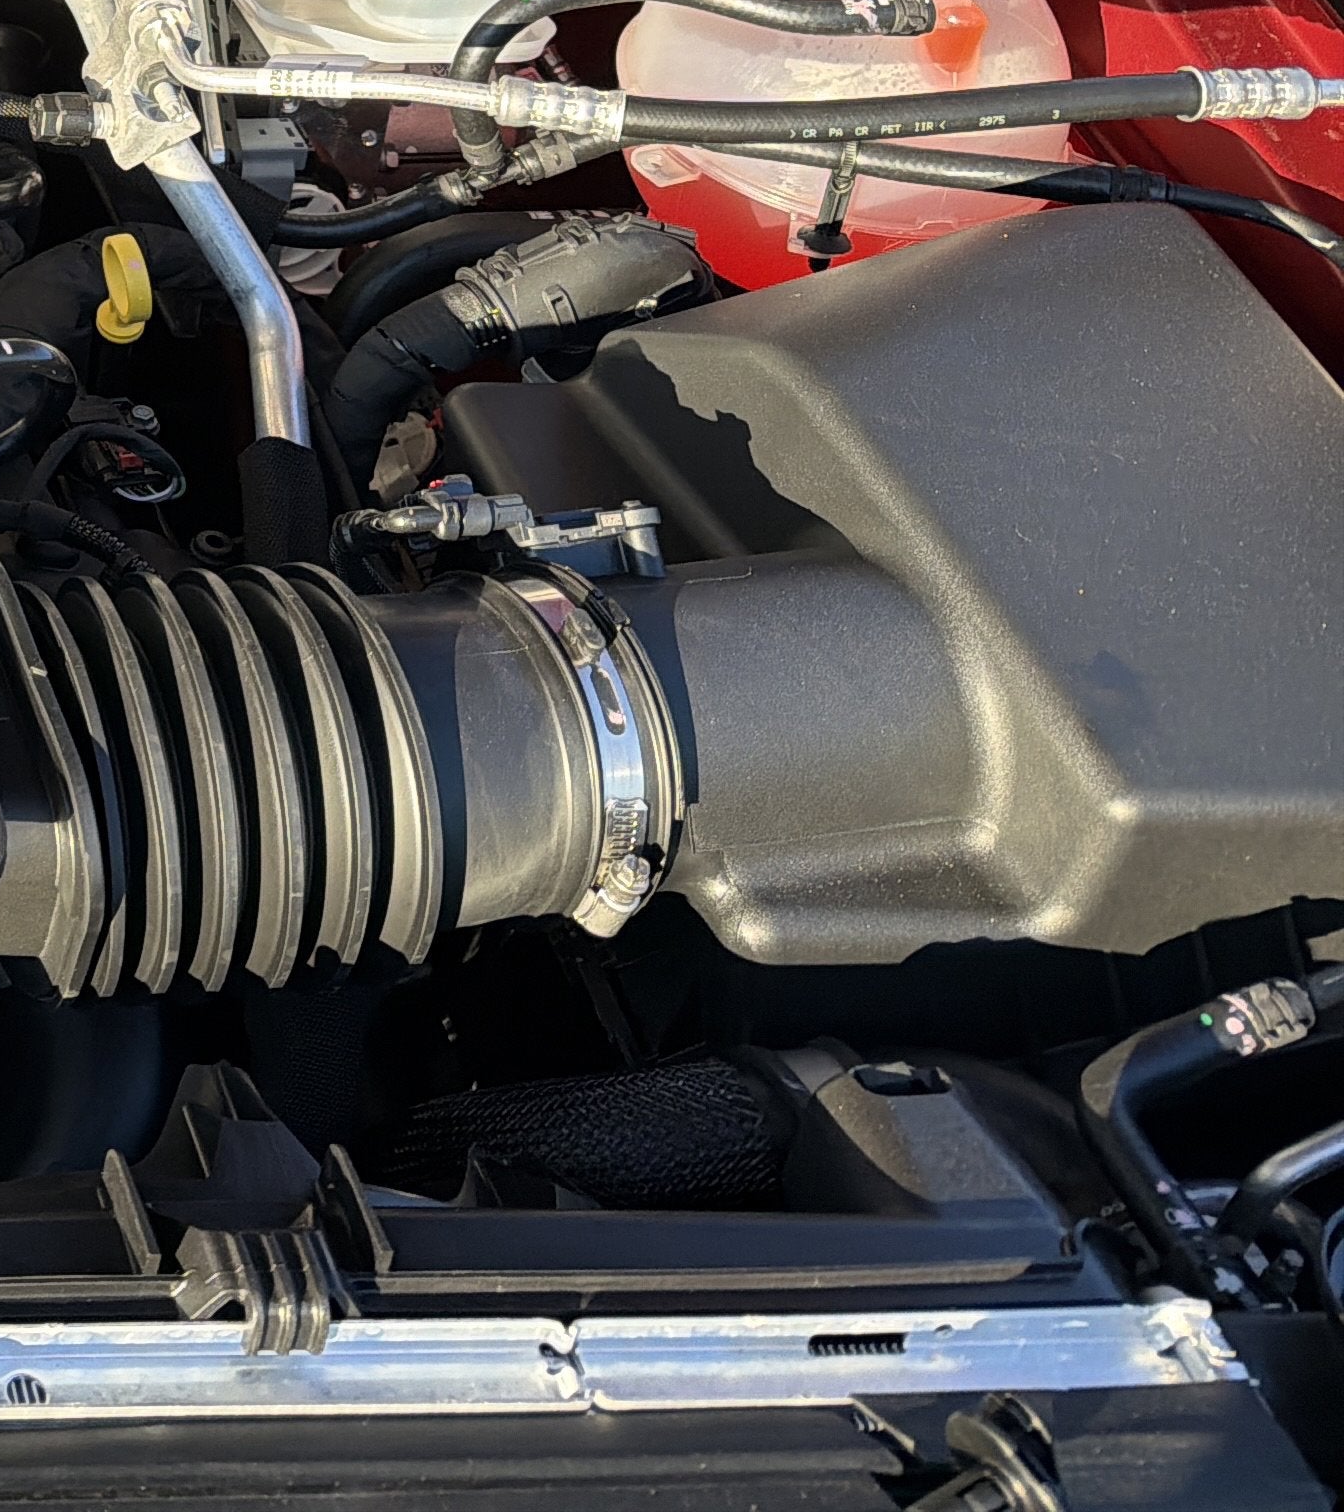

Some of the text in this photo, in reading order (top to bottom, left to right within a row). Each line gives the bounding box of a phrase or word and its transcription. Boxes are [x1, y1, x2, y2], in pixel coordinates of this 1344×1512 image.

[829, 127, 844, 138] PA
[855, 126, 869, 137] CR
[881, 123, 902, 135] PET
[979, 115, 1006, 127] 2975
[1052, 109, 1060, 120] 3
